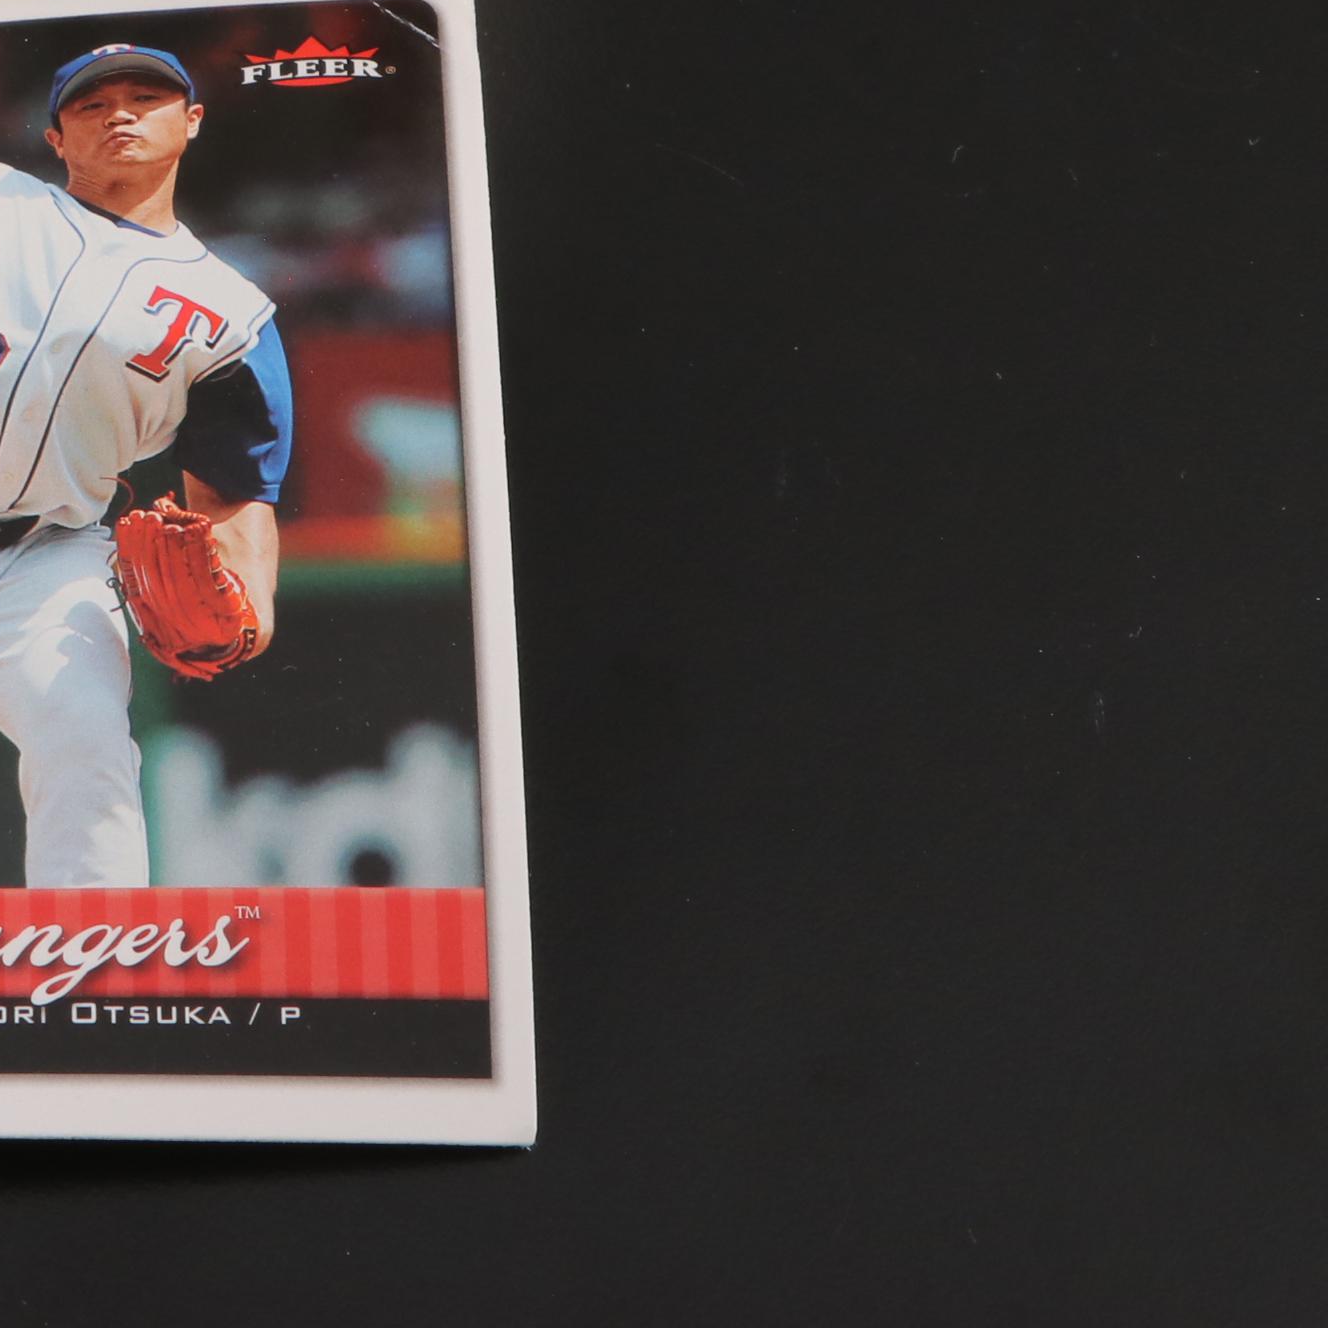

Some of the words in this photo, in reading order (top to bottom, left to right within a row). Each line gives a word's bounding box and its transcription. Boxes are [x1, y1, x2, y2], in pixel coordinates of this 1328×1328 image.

[240, 57, 383, 85] FLEER
[125, 284, 228, 383] T
[71, 1002, 232, 1025] OTSUKA
[280, 1005, 301, 1024] P
